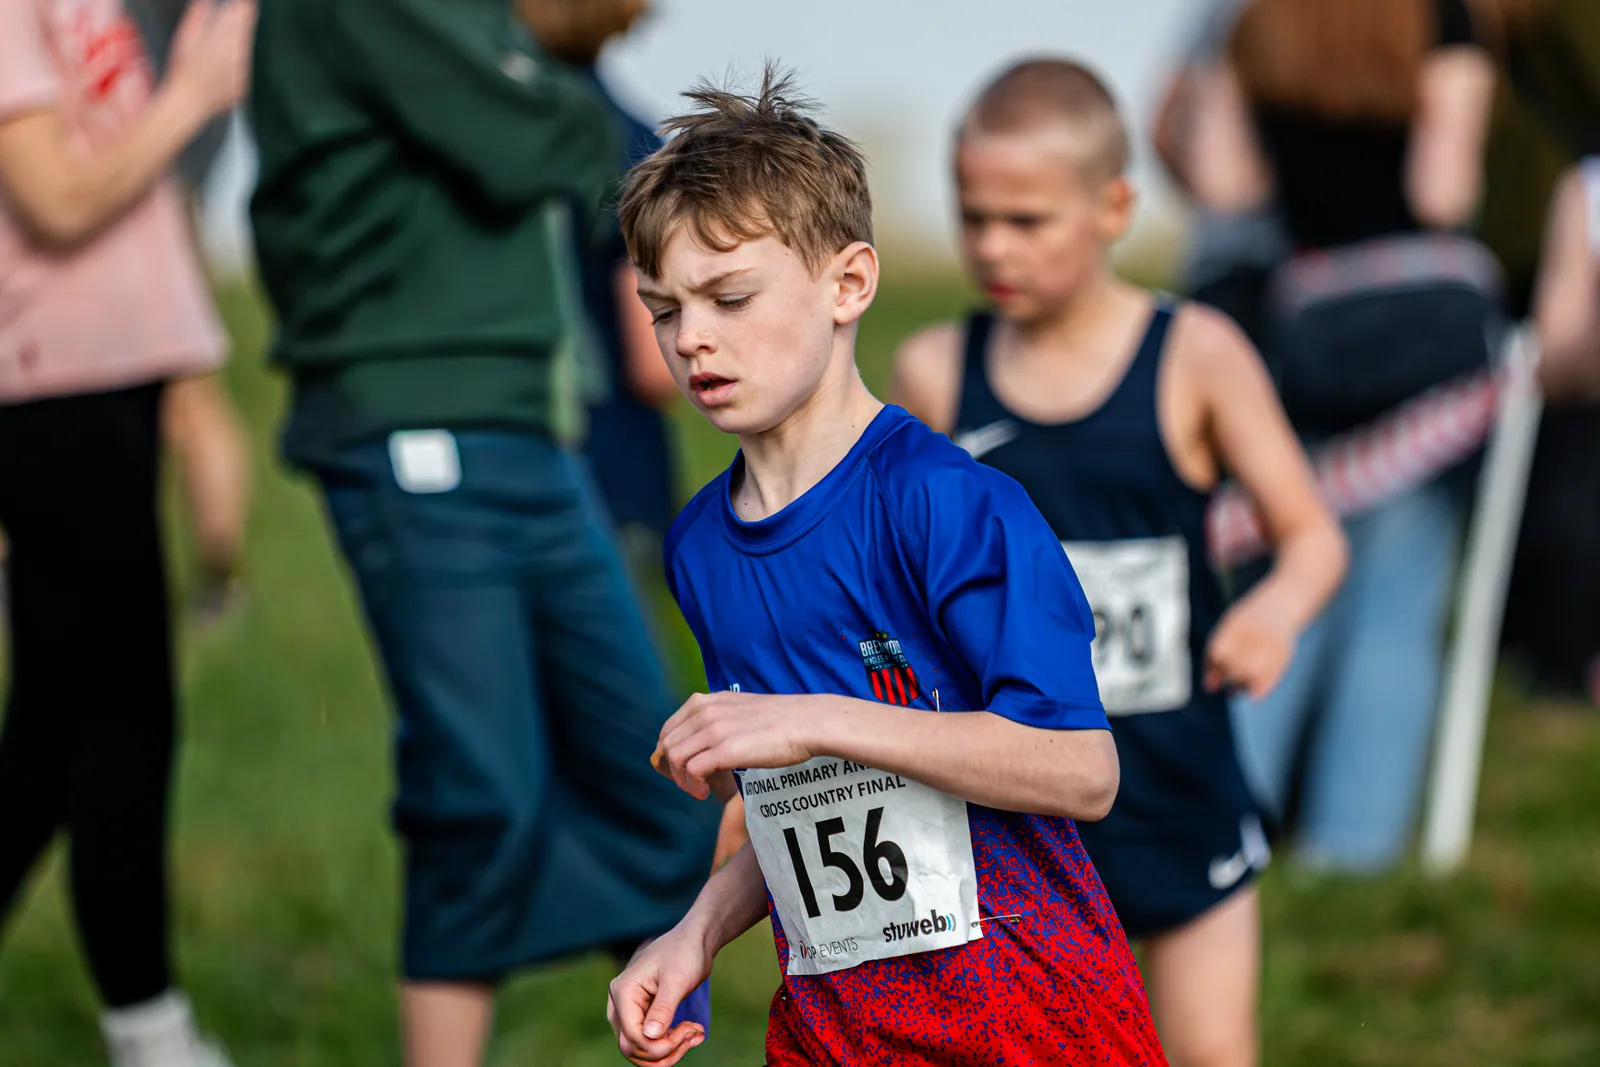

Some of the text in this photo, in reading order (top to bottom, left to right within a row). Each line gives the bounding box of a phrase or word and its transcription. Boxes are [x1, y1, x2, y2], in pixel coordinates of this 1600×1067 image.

[745, 760, 872, 796] TIONAL PRIMARY AN
[760, 774, 906, 818] CROSS COUNTRY FINAL
[783, 806, 908, 918] 156
[882, 909, 948, 943] stuweb
[819, 938, 859, 958] EVENTS
